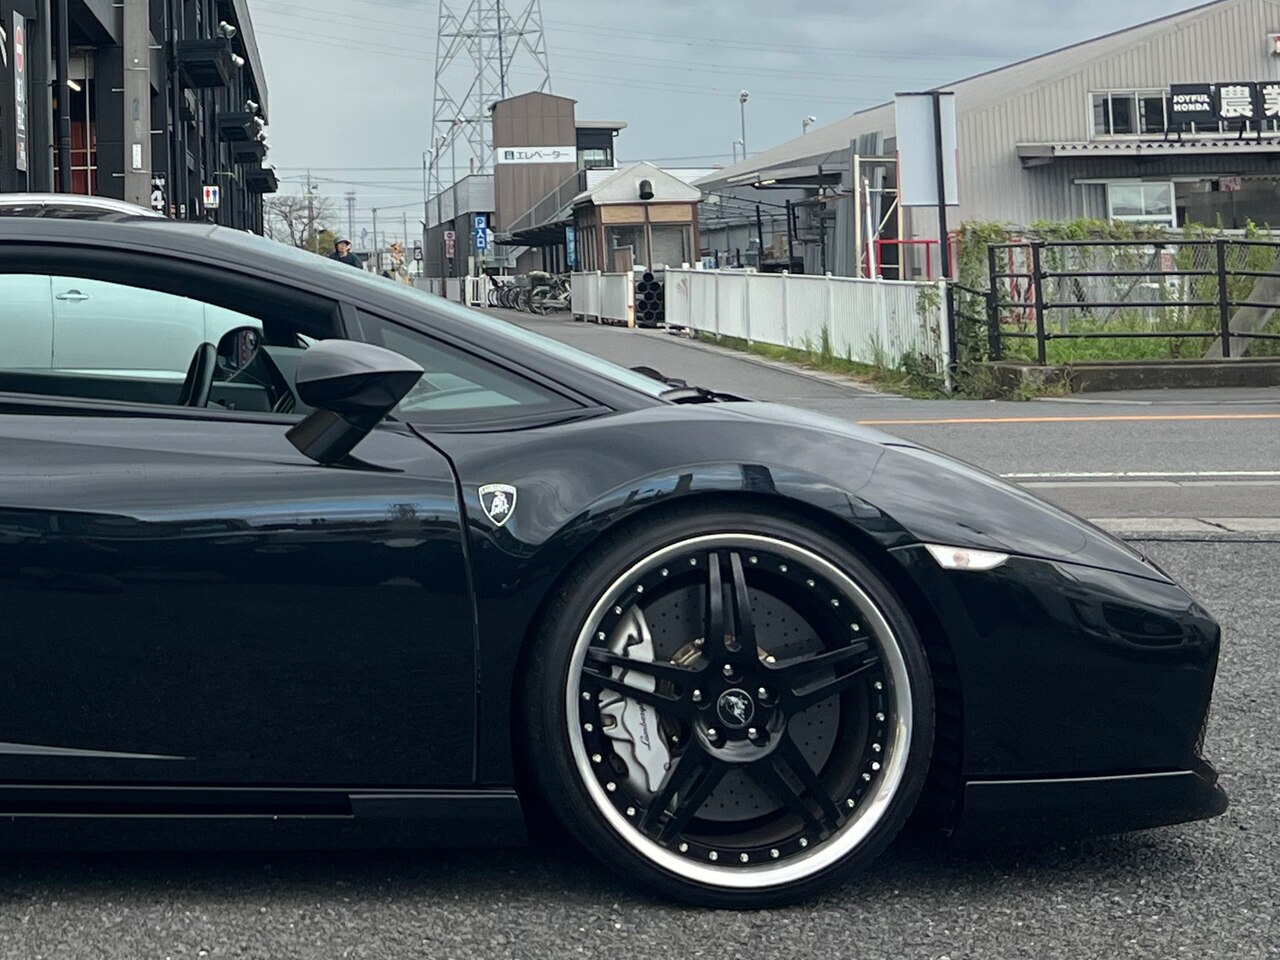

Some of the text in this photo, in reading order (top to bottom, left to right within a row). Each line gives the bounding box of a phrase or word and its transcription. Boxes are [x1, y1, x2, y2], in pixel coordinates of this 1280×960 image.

[1173, 94, 1209, 102] JOYFUL
[1174, 103, 1209, 111] HONDA
[516, 150, 569, 160] エレベーター
[476, 229, 486, 247] 入口
